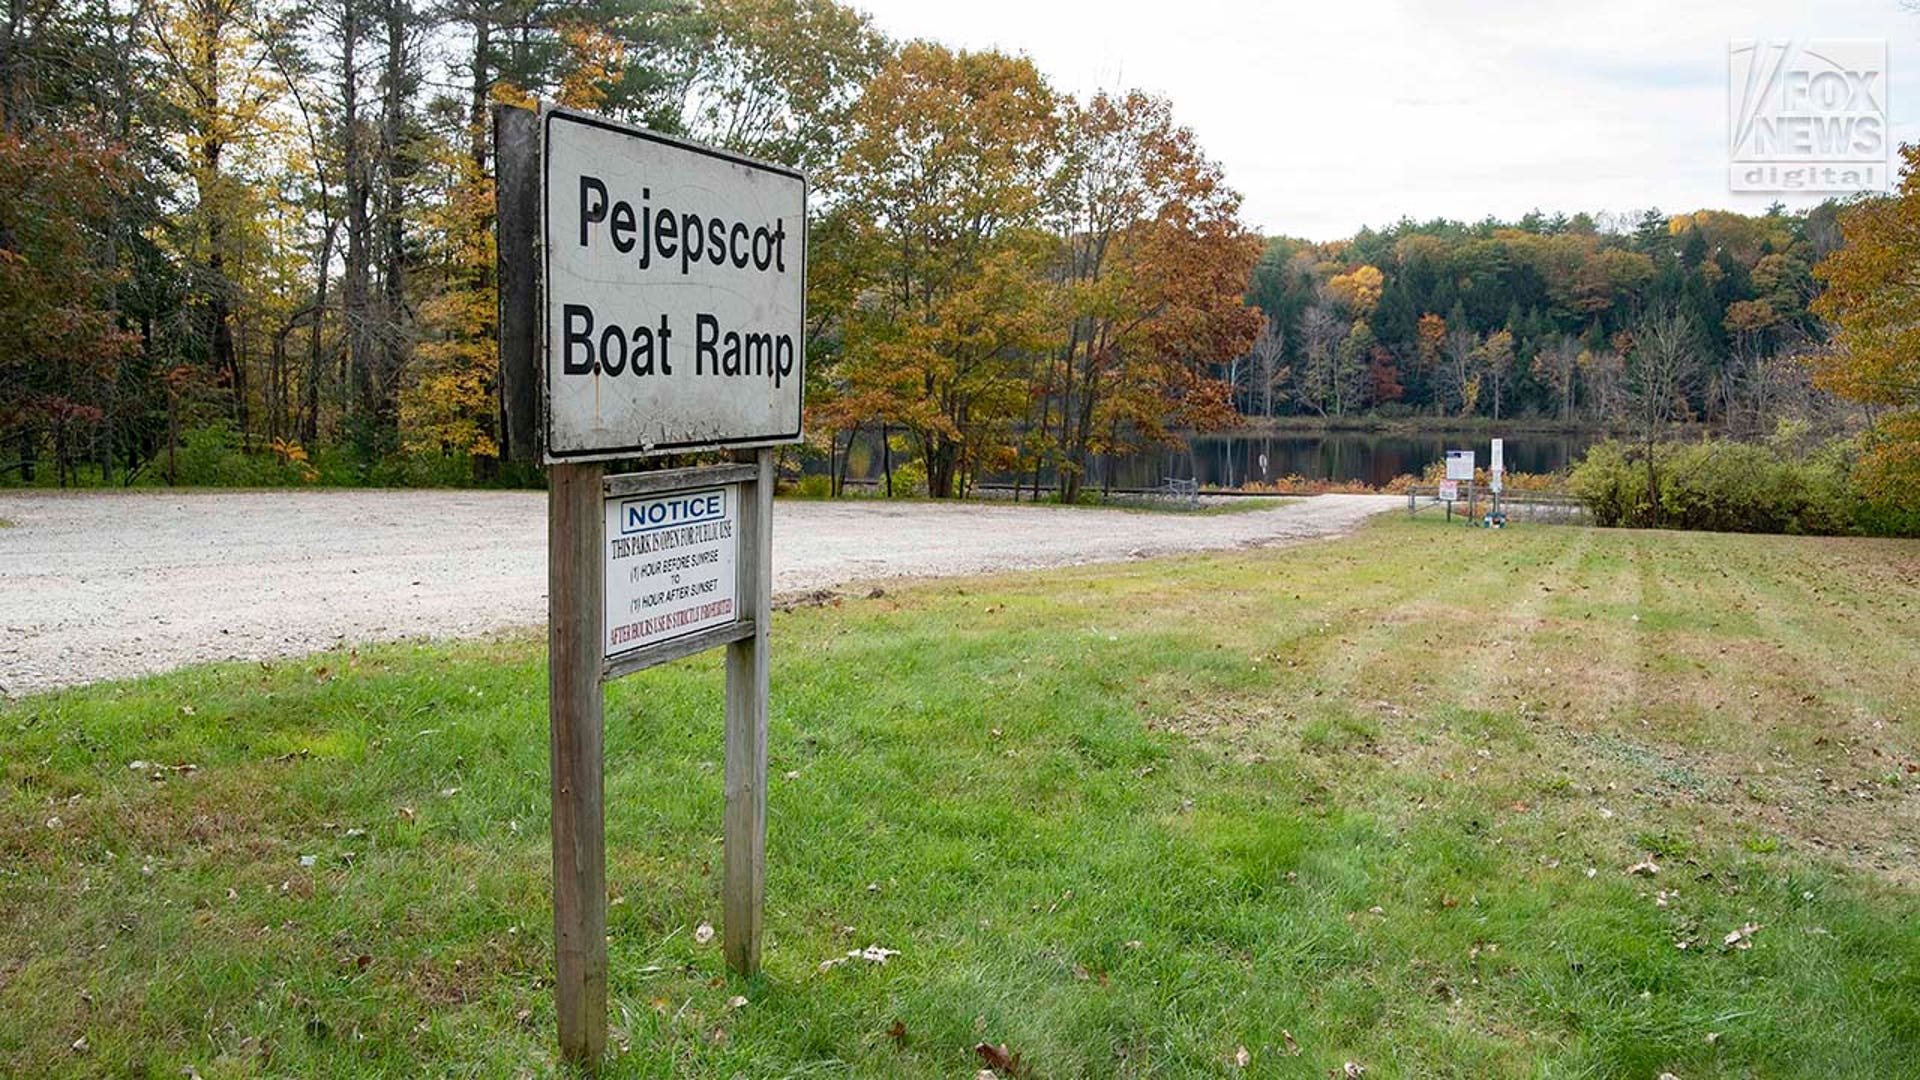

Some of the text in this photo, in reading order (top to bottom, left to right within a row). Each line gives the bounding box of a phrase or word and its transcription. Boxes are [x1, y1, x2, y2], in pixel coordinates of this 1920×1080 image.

[580, 175, 785, 275] Pejepscot
[563, 304, 793, 388] Boat Ramp
[629, 496, 720, 527] NOTICE
[611, 537, 630, 559] THIS
[632, 533, 651, 556] PARK
[660, 529, 680, 550] OPEN
[681, 526, 695, 547] FOR
[695, 521, 719, 544] PUBLIC
[719, 519, 732, 539] USE
[641, 560, 662, 578] HOUR
[663, 555, 691, 573] BEFORE
[691, 549, 719, 566] SUNRISE
[642, 592, 665, 609] HOUR
[665, 585, 690, 603] AFTER
[690, 578, 718, 597] SUNSET
[671, 574, 680, 585] TO
